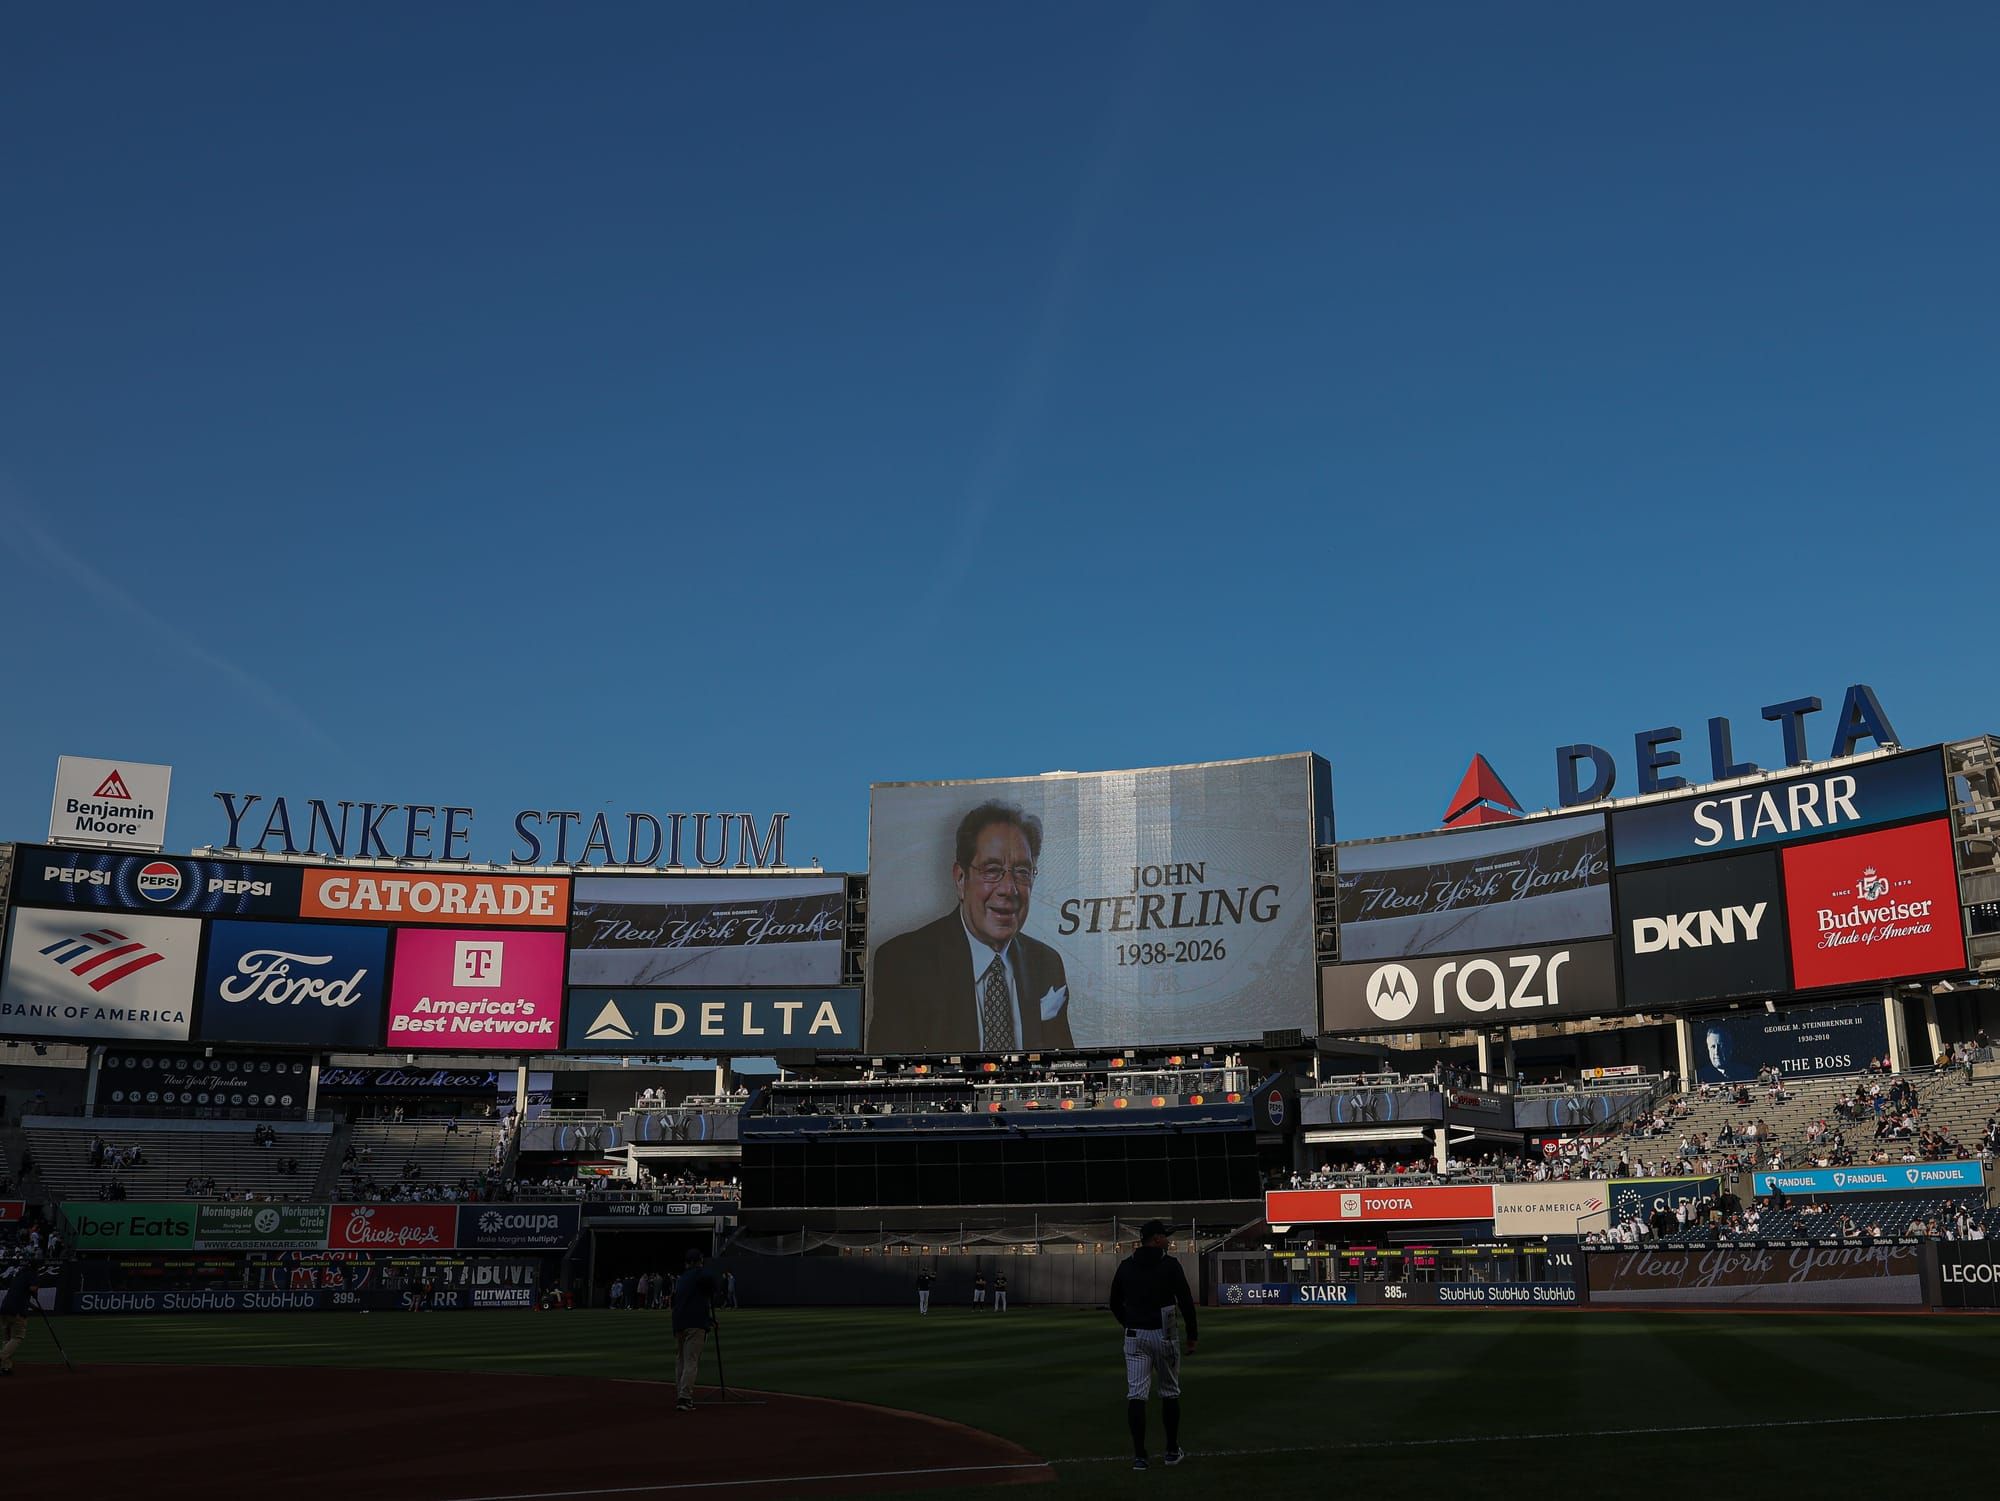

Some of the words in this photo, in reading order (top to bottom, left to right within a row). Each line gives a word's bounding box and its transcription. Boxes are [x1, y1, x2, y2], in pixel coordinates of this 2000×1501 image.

[1556, 683, 1902, 806] DELTA
[66, 799, 154, 820] Benjamin
[1693, 775, 1861, 847] STARR
[75, 816, 138, 835] Moore
[213, 791, 474, 863] YANKEE
[510, 810, 790, 868] STADIUM
[44, 866, 111, 886] PEPSI
[140, 876, 178, 887] PEPSI
[1130, 862, 1206, 893] JOHN
[208, 879, 272, 896] PEPSI
[318, 877, 556, 916] GATORADE
[1360, 887, 1429, 913] New
[1432, 872, 1503, 913] York
[1832, 889, 1851, 897] SINCE
[1058, 884, 1280, 935] STERLING
[1817, 899, 1932, 931] Budweiser
[594, 919, 664, 942] New
[668, 919, 739, 948] York
[1632, 902, 1768, 954] DKNY
[1818, 930, 1860, 949] Made
[1861, 926, 1877, 945] of
[1873, 922, 1932, 941] America
[1117, 938, 1226, 966] 1938-2026
[219, 950, 367, 1008] Ford
[1433, 951, 1570, 1014] razr
[1, 1003, 58, 1018] BANK
[64, 1006, 89, 1019] OF
[94, 1007, 185, 1023] AMERICA
[412, 997, 535, 1015] America’s
[391, 1015, 446, 1032] Best
[450, 1016, 554, 1034] Network
[654, 1001, 843, 1036] DELTA
[1764, 1023, 1793, 1033] GEORGE
[1802, 1018, 1853, 1030] STEINBRENNER
[1855, 1017, 1863, 1025] III
[1798, 1033, 1830, 1043] 1930-2010
[1781, 1058, 1811, 1072] THE
[1815, 1054, 1852, 1069] BOSS
[162, 1074, 184, 1086] New
[184, 1074, 209, 1090] York
[209, 1075, 249, 1090] Yankees
[1778, 1177, 1816, 1187] FANDUEL
[1847, 1173, 1887, 1184] FANDUEL
[1920, 1169, 1964, 1180] FANDUEL
[202, 1206, 253, 1219] Morningside
[281, 1206, 326, 1217] Workmen's
[609, 1205, 635, 1213] WATCH
[653, 1205, 663, 1213] ON
[1364, 1198, 1413, 1210] TOYOTA
[1497, 1204, 1523, 1214] BANK
[1525, 1204, 1537, 1213] OF
[1538, 1203, 1582, 1212] AMERICA
[129, 1216, 190, 1236] Eats
[300, 1217, 324, 1227] Circle
[345, 1213, 440, 1244] Chick-fil-A
[504, 1214, 559, 1233] coupa
[80, 1292, 156, 1310] StubHub
[162, 1292, 236, 1310] StubHub
[242, 1291, 315, 1308] StubHub
[401, 1292, 458, 1307] SRR
[474, 1289, 530, 1300] CUTWATER
[1247, 1289, 1279, 1299] CLEAR
[1300, 1285, 1347, 1301] STARR
[1439, 1287, 1485, 1300] StubHub
[1488, 1286, 1530, 1300] StubHub
[1533, 1286, 1576, 1301] StubHub
